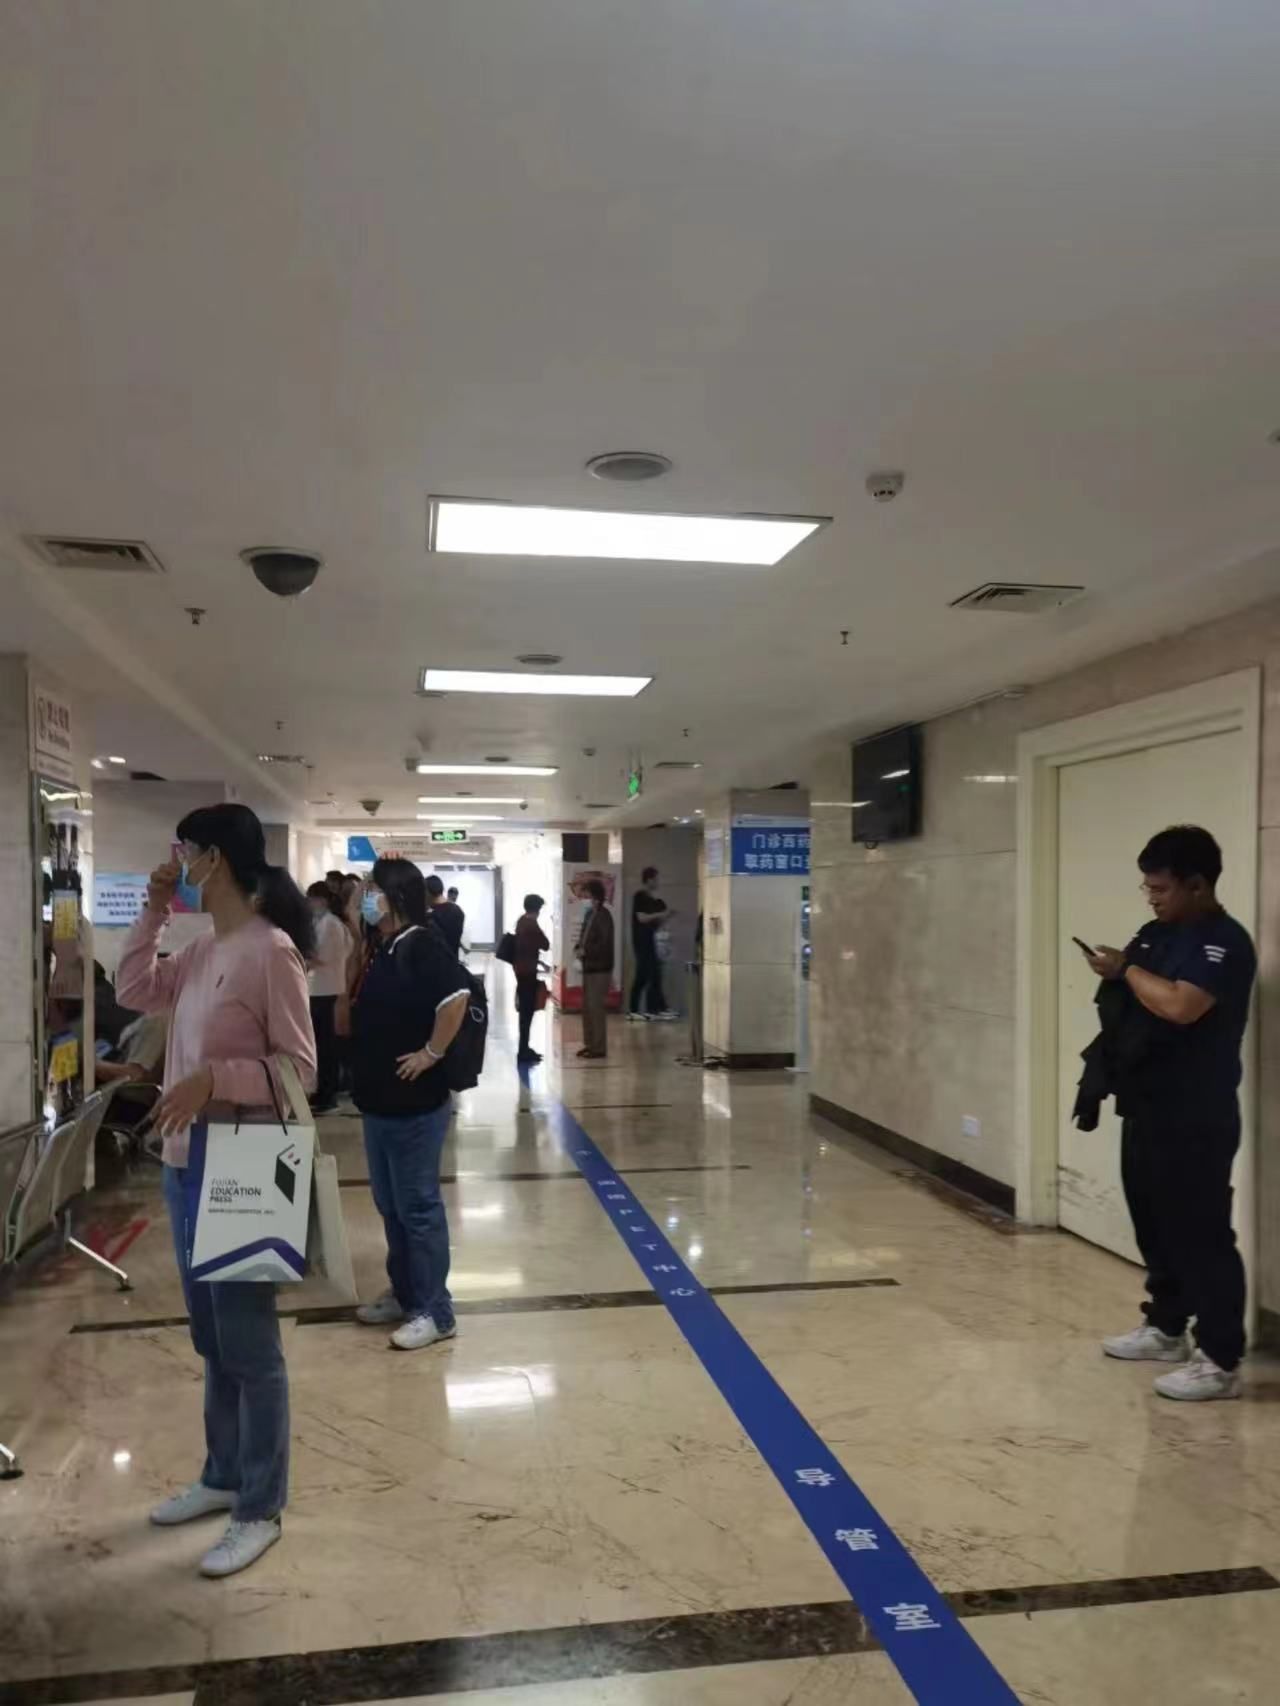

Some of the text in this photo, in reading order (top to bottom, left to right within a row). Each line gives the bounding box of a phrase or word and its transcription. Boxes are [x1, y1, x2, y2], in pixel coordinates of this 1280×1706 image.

[744, 853, 810, 869] 取药窗口
[210, 1186, 262, 1196] EDUCATION
[794, 1467, 942, 1632] 导管室
